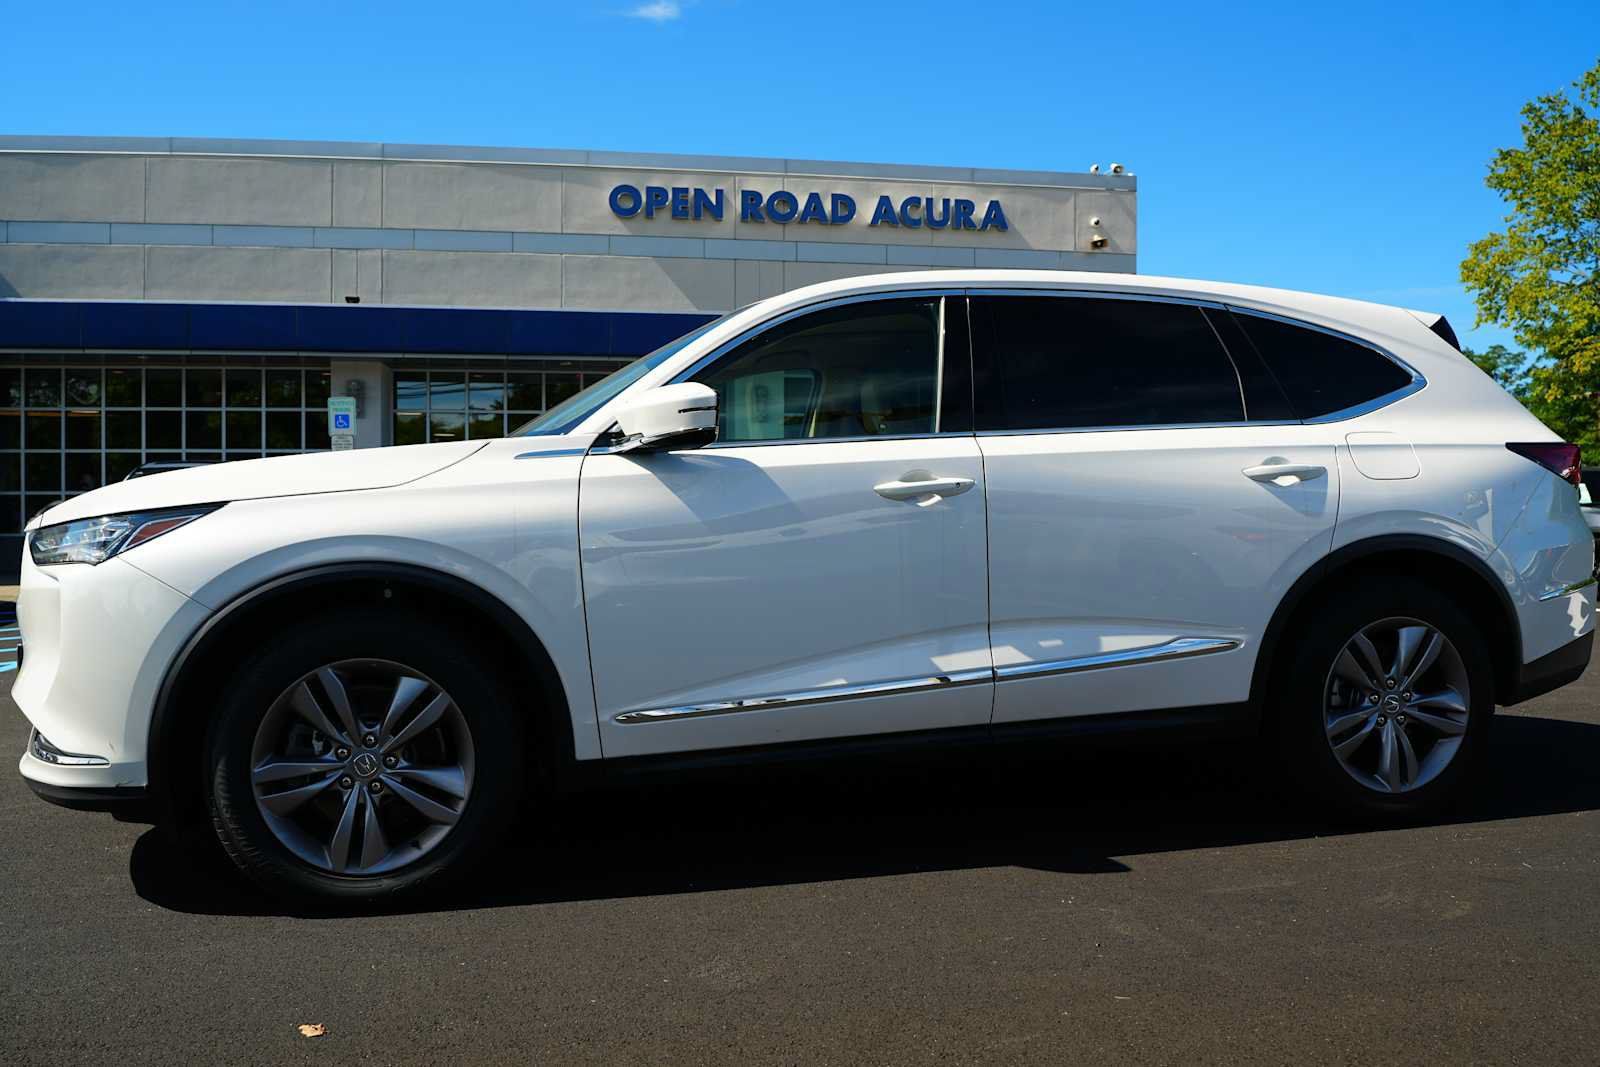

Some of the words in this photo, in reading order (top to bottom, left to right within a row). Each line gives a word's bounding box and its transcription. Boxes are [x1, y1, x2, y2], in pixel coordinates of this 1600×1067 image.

[608, 184, 724, 221] OPEN
[740, 190, 856, 225] ROAD
[869, 195, 1009, 232] ACURA
